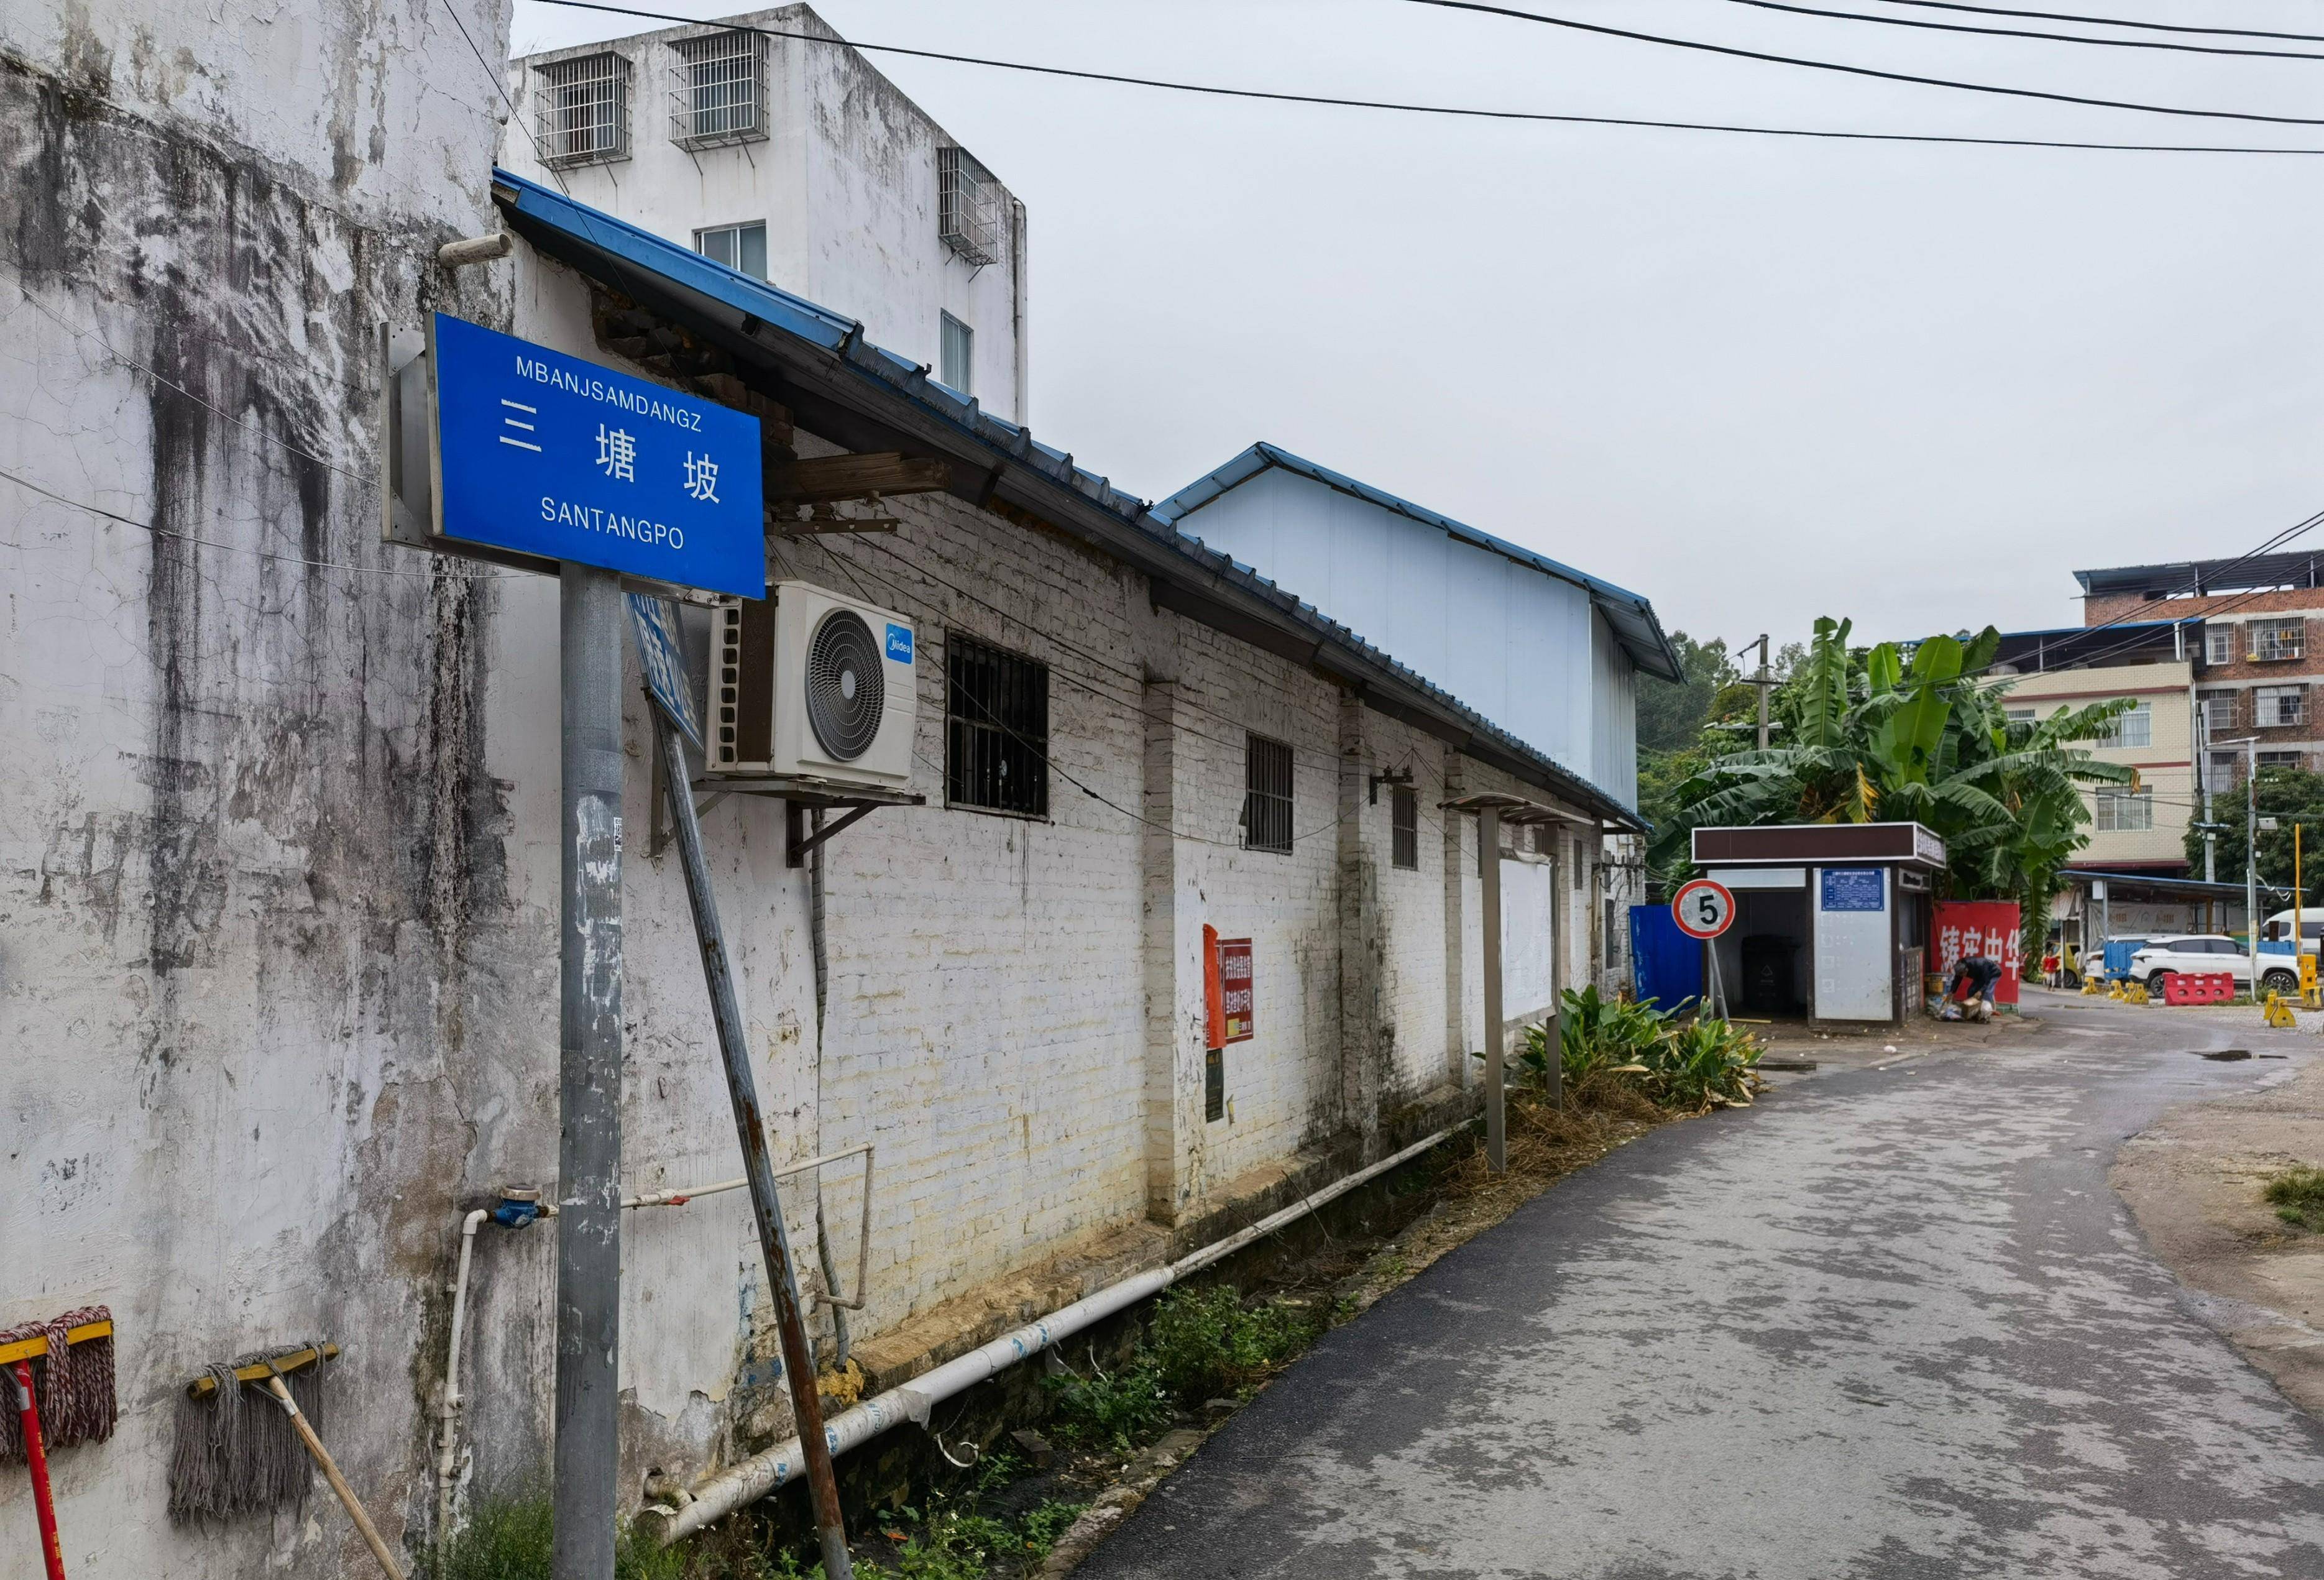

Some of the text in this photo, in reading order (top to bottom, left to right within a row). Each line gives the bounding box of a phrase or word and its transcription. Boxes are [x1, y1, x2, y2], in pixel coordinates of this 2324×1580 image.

[516, 356, 702, 433] MBANJSAMDANGZ
[498, 398, 720, 504] 三塘坡
[541, 497, 684, 549] SANTANGPO
[887, 633, 911, 654] Midea
[1699, 894, 1718, 925] 5
